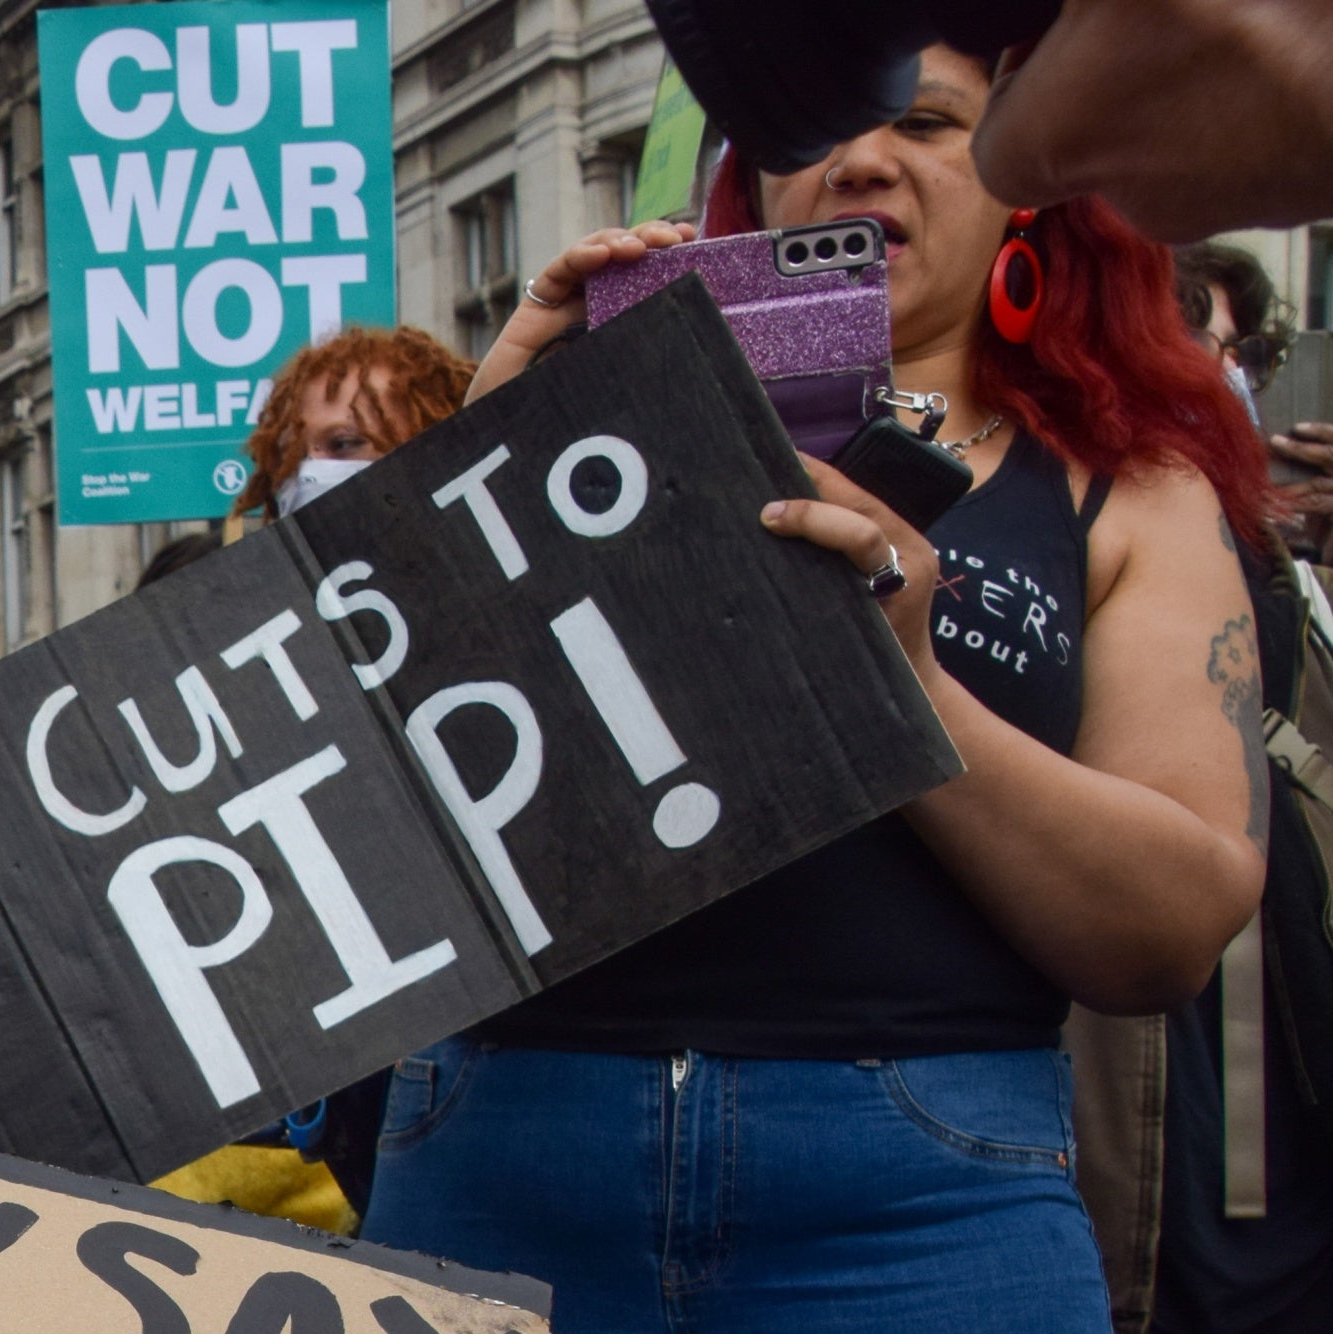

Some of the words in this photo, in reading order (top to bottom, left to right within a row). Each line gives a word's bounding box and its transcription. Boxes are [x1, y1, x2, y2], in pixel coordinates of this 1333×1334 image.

[76, 20, 357, 139] CUT
[70, 142, 367, 253] WAR
[86, 255, 367, 373] NOT
[433, 436, 647, 579] TO
[108, 598, 719, 1108] PIP!
